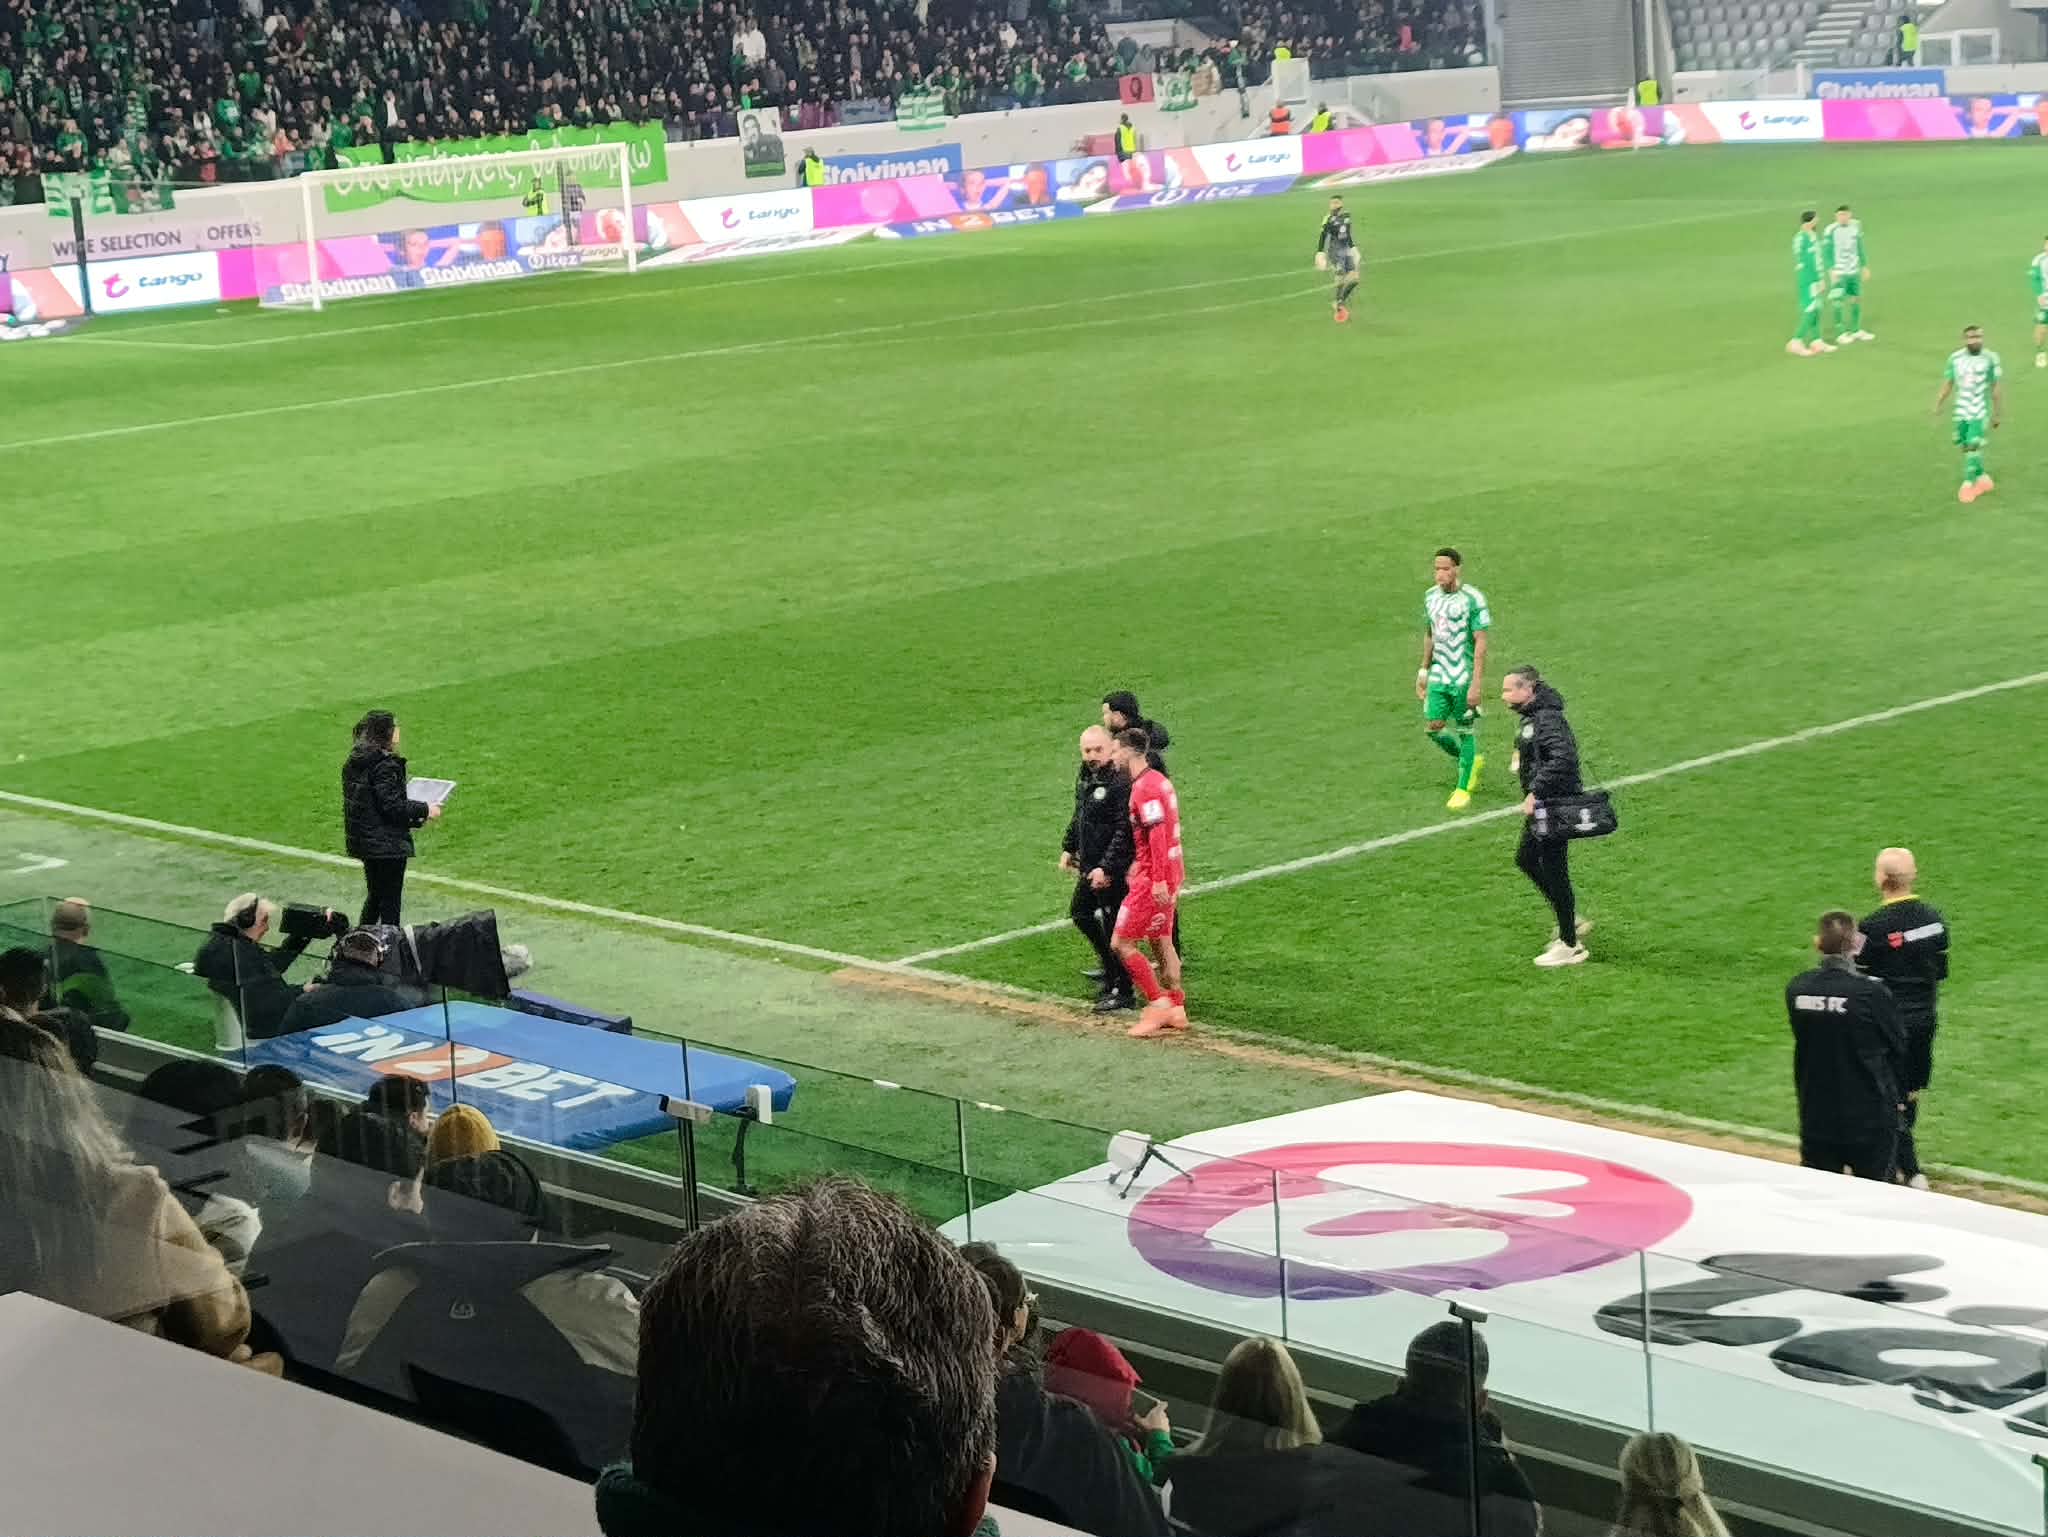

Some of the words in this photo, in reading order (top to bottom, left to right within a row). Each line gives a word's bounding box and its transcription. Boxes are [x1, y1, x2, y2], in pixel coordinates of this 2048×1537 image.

[53, 239, 95, 256] WIE
[100, 229, 182, 253] SELECTION
[139, 272, 203, 287] tango
[280, 275, 397, 299] Stiximan
